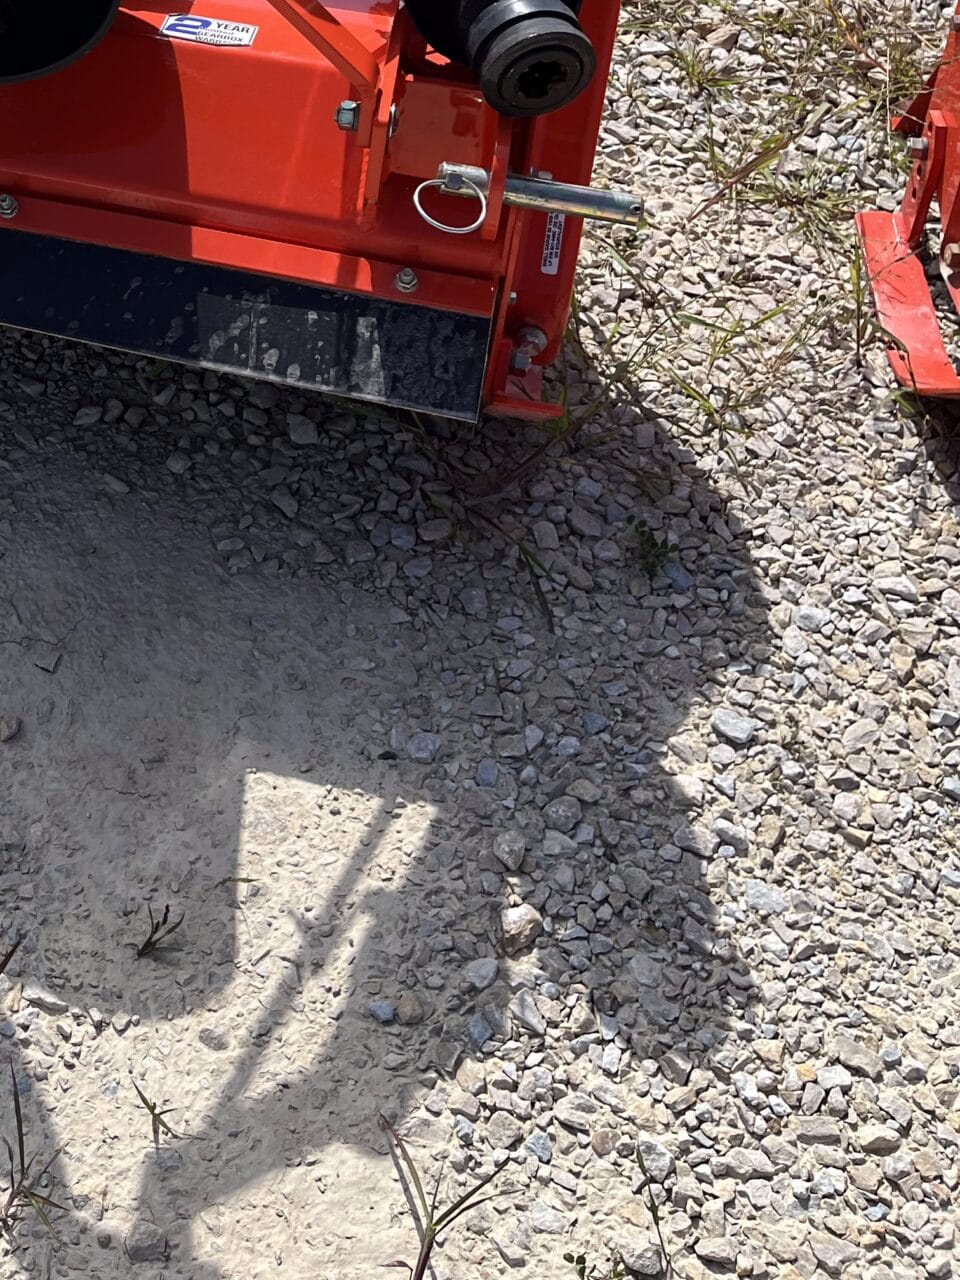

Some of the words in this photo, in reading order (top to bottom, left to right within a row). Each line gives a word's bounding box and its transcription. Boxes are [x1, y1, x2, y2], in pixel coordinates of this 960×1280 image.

[165, 16, 212, 36] 2
[216, 22, 250, 33] YEAR
[196, 31, 244, 42] GEARBOX
